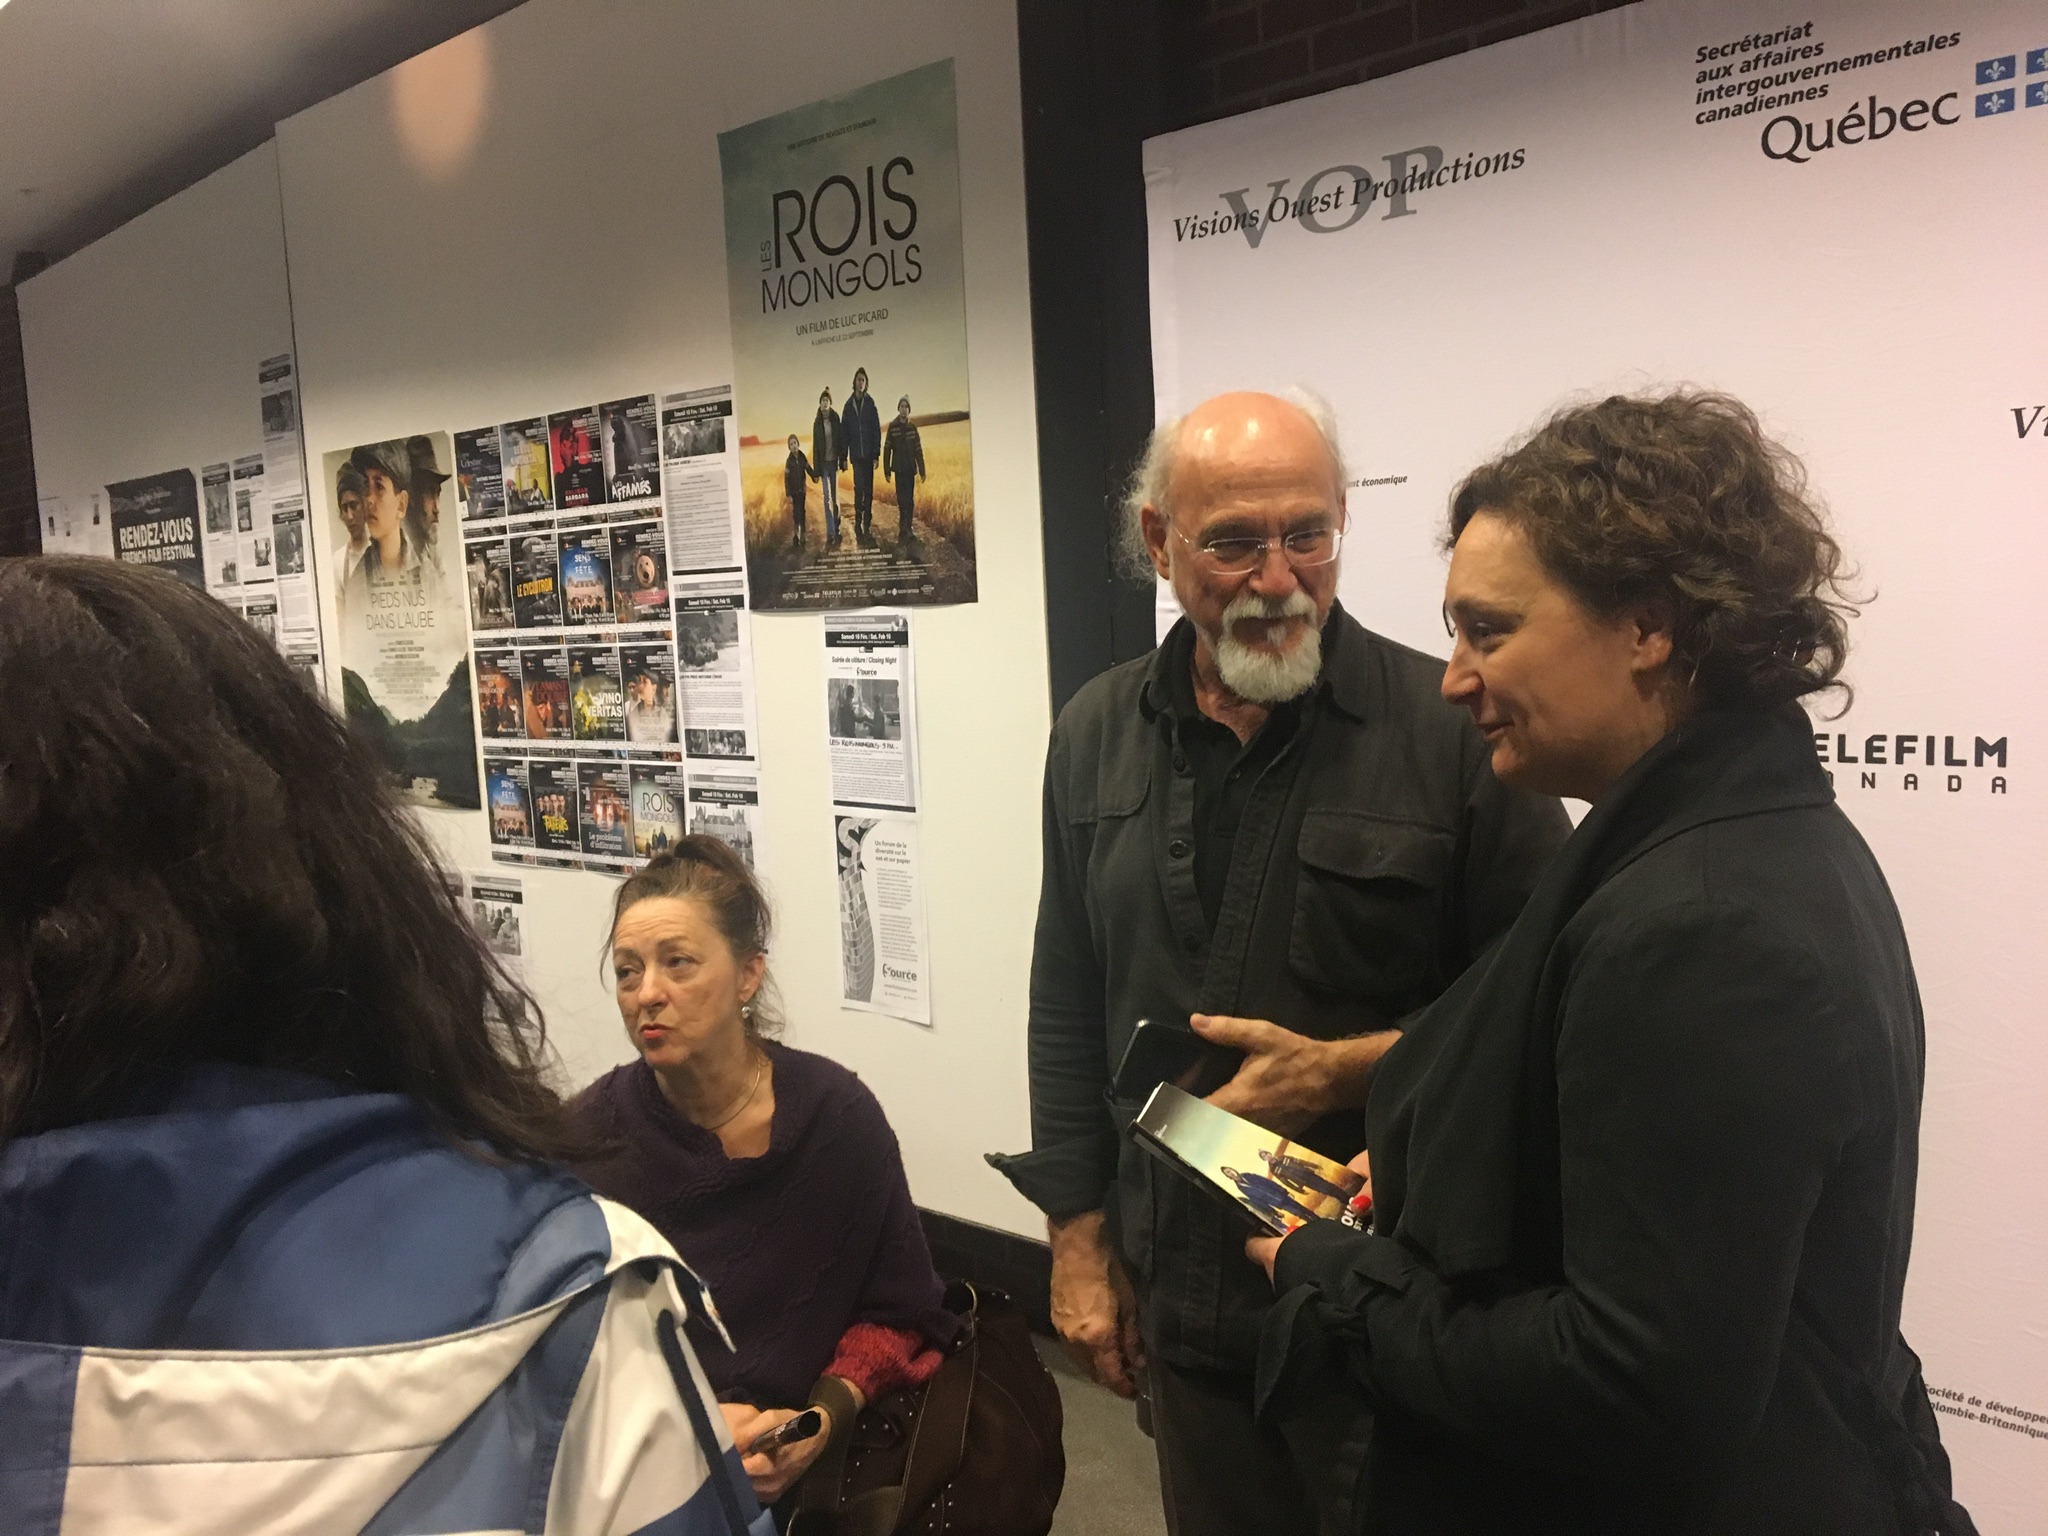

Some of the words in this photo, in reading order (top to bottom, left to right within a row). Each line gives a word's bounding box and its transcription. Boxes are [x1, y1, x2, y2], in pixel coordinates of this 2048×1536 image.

[1696, 21, 1813, 63] Secrétariat
[1696, 66, 1733, 84] aux
[1739, 42, 1825, 74] affaires
[1696, 32, 1962, 105] intergouvernementales
[1696, 83, 1830, 125] canadiennes
[1761, 92, 1961, 164] Québec
[1174, 208, 1260, 242] Visions
[1268, 186, 1345, 225] Ouest
[1350, 148, 1525, 206] Productions
[1219, 145, 1444, 249] VOP
[772, 156, 917, 269] ROIS
[760, 239, 772, 272] LES
[762, 243, 922, 314] MONGOLS
[796, 323, 808, 336] UN
[809, 320, 828, 334] FILM
[828, 318, 840, 330] DE
[841, 314, 857, 328] LUC
[858, 308, 889, 324] PICARD
[1361, 475, 1408, 487] économique
[120, 516, 194, 550] RENDEZ-VOUS
[147, 547, 162, 563] FILM
[162, 543, 196, 561] FESTIVAL
[370, 591, 401, 609] PIEDS
[402, 589, 426, 607] NUS
[366, 612, 395, 631] DANS
[397, 610, 435, 629] L'AUBE
[868, 656, 885, 665] Closing
[885, 657, 897, 665] Night
[586, 705, 623, 718] VERITAS
[599, 692, 622, 705] VINO
[642, 792, 675, 813] ROIS
[640, 811, 676, 824] MONGOLS
[588, 831, 596, 840] Le
[596, 832, 622, 843] problème
[1967, 1396, 1982, 1407] de
[1986, 1401, 2048, 1424] développe
